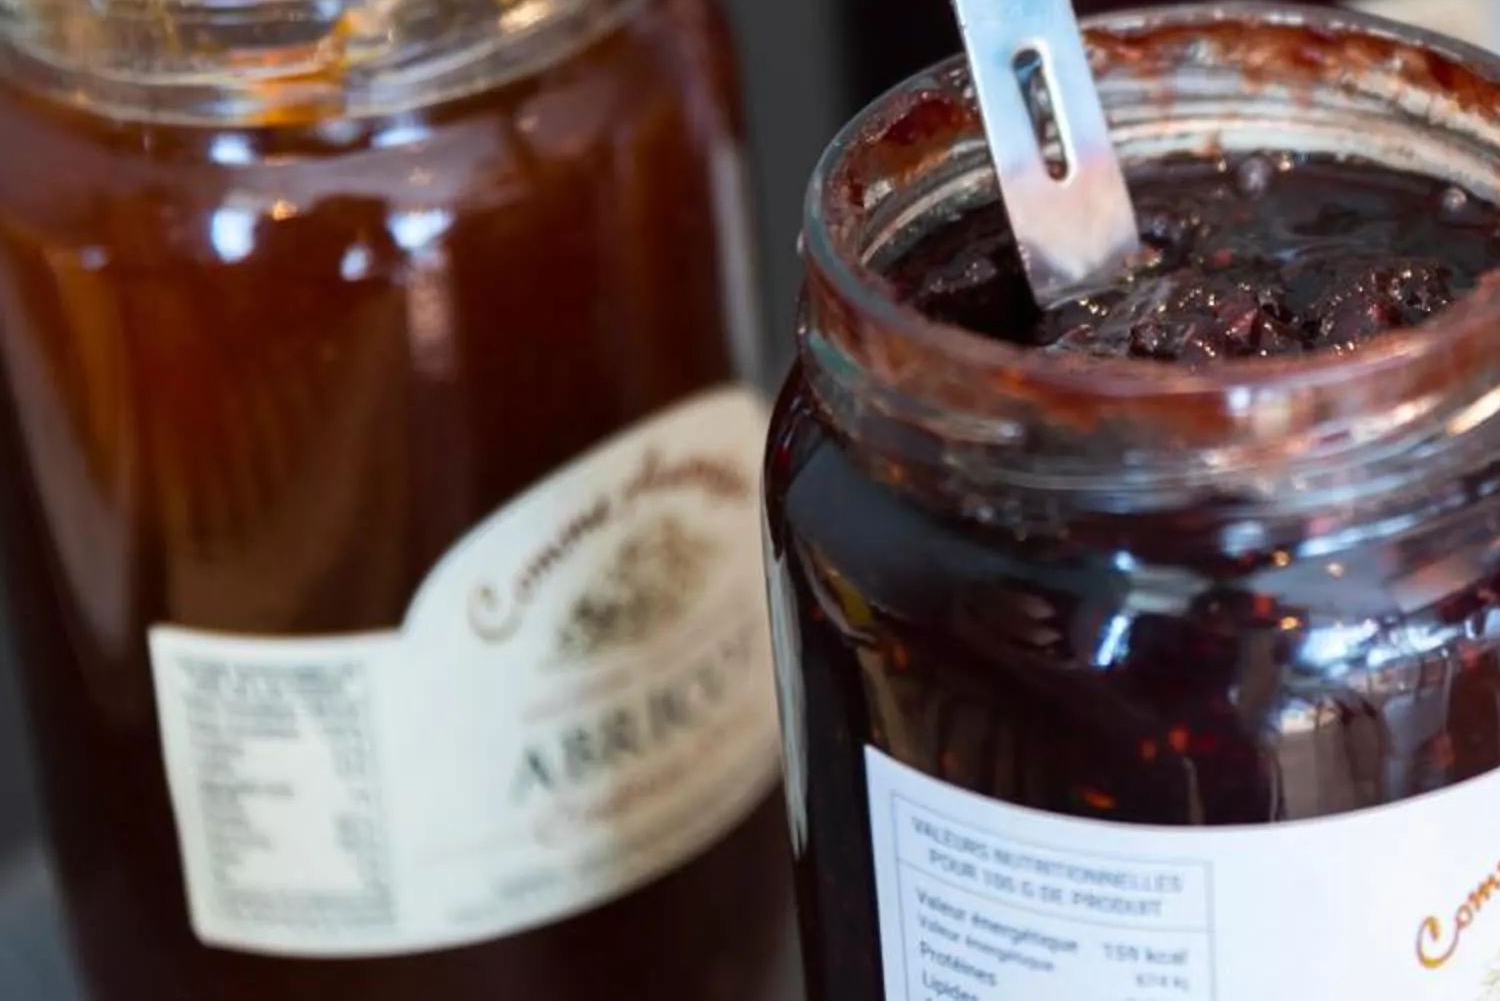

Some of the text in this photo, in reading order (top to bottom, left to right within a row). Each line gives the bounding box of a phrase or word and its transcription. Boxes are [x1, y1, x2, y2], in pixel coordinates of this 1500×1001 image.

[912, 817, 1184, 892] VALEURS NUTRITIONNELLES
[929, 847, 977, 879] POUR
[1072, 890, 1163, 917] PRODUIT
[915, 886, 967, 922] Valeur
[919, 937, 998, 988] Protéines
